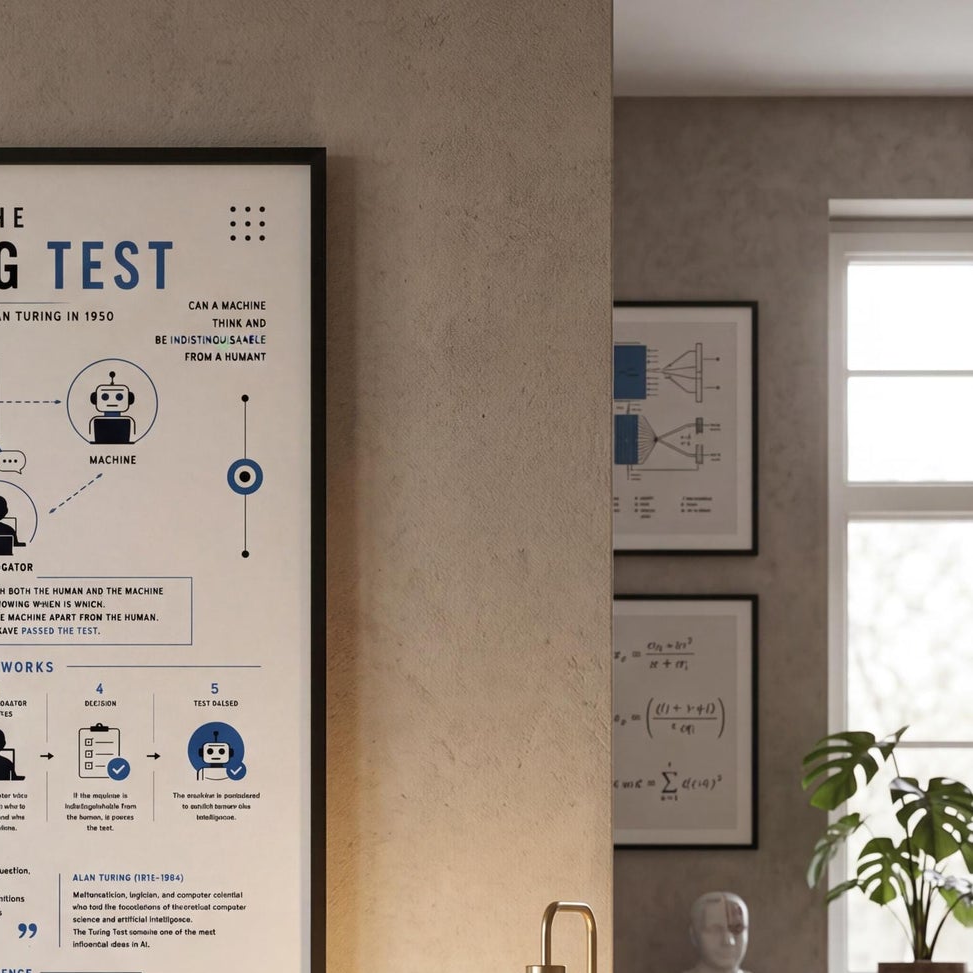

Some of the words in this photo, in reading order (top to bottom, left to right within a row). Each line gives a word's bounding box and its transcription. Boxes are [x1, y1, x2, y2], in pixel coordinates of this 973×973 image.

[47, 241, 173, 290] TEST
[188, 300, 209, 311] CAN
[211, 301, 219, 310] A
[221, 300, 266, 311] MACHINE
[15, 310, 62, 322] TURING
[67, 311, 79, 322] IN
[85, 310, 114, 322] 1950
[212, 318, 243, 328] THINK
[245, 318, 267, 328] AND
[155, 335, 167, 345] BE
[184, 351, 213, 362] FROM
[214, 352, 222, 362] A
[224, 352, 267, 362] HUMANT
[89, 455, 137, 465] MACHINE
[8, 586, 31, 596] BOTH
[33, 587, 50, 596] THE
[52, 587, 84, 595] HUMAN
[85, 587, 104, 596] AND
[106, 586, 123, 596] THE
[124, 587, 164, 596] MACHINE
[63, 600, 72, 609] IS
[7, 613, 47, 622] MACHINE
[49, 613, 77, 622] APART
[105, 613, 122, 622] THE
[124, 613, 159, 622] HUMAN.
[21, 626, 55, 635] PASSED
[57, 626, 74, 635] THE
[77, 626, 101, 635] TEST.
[0, 661, 54, 673] WORKS
[95, 682, 104, 695] 4
[210, 682, 219, 695] 5
[193, 699, 211, 707] TEST
[72, 873, 96, 882] ALAN
[98, 873, 132, 882] TURING
[162, 903, 171, 911] of
[72, 928, 87, 936] The
[174, 928, 183, 936] of
[184, 928, 197, 936] the
